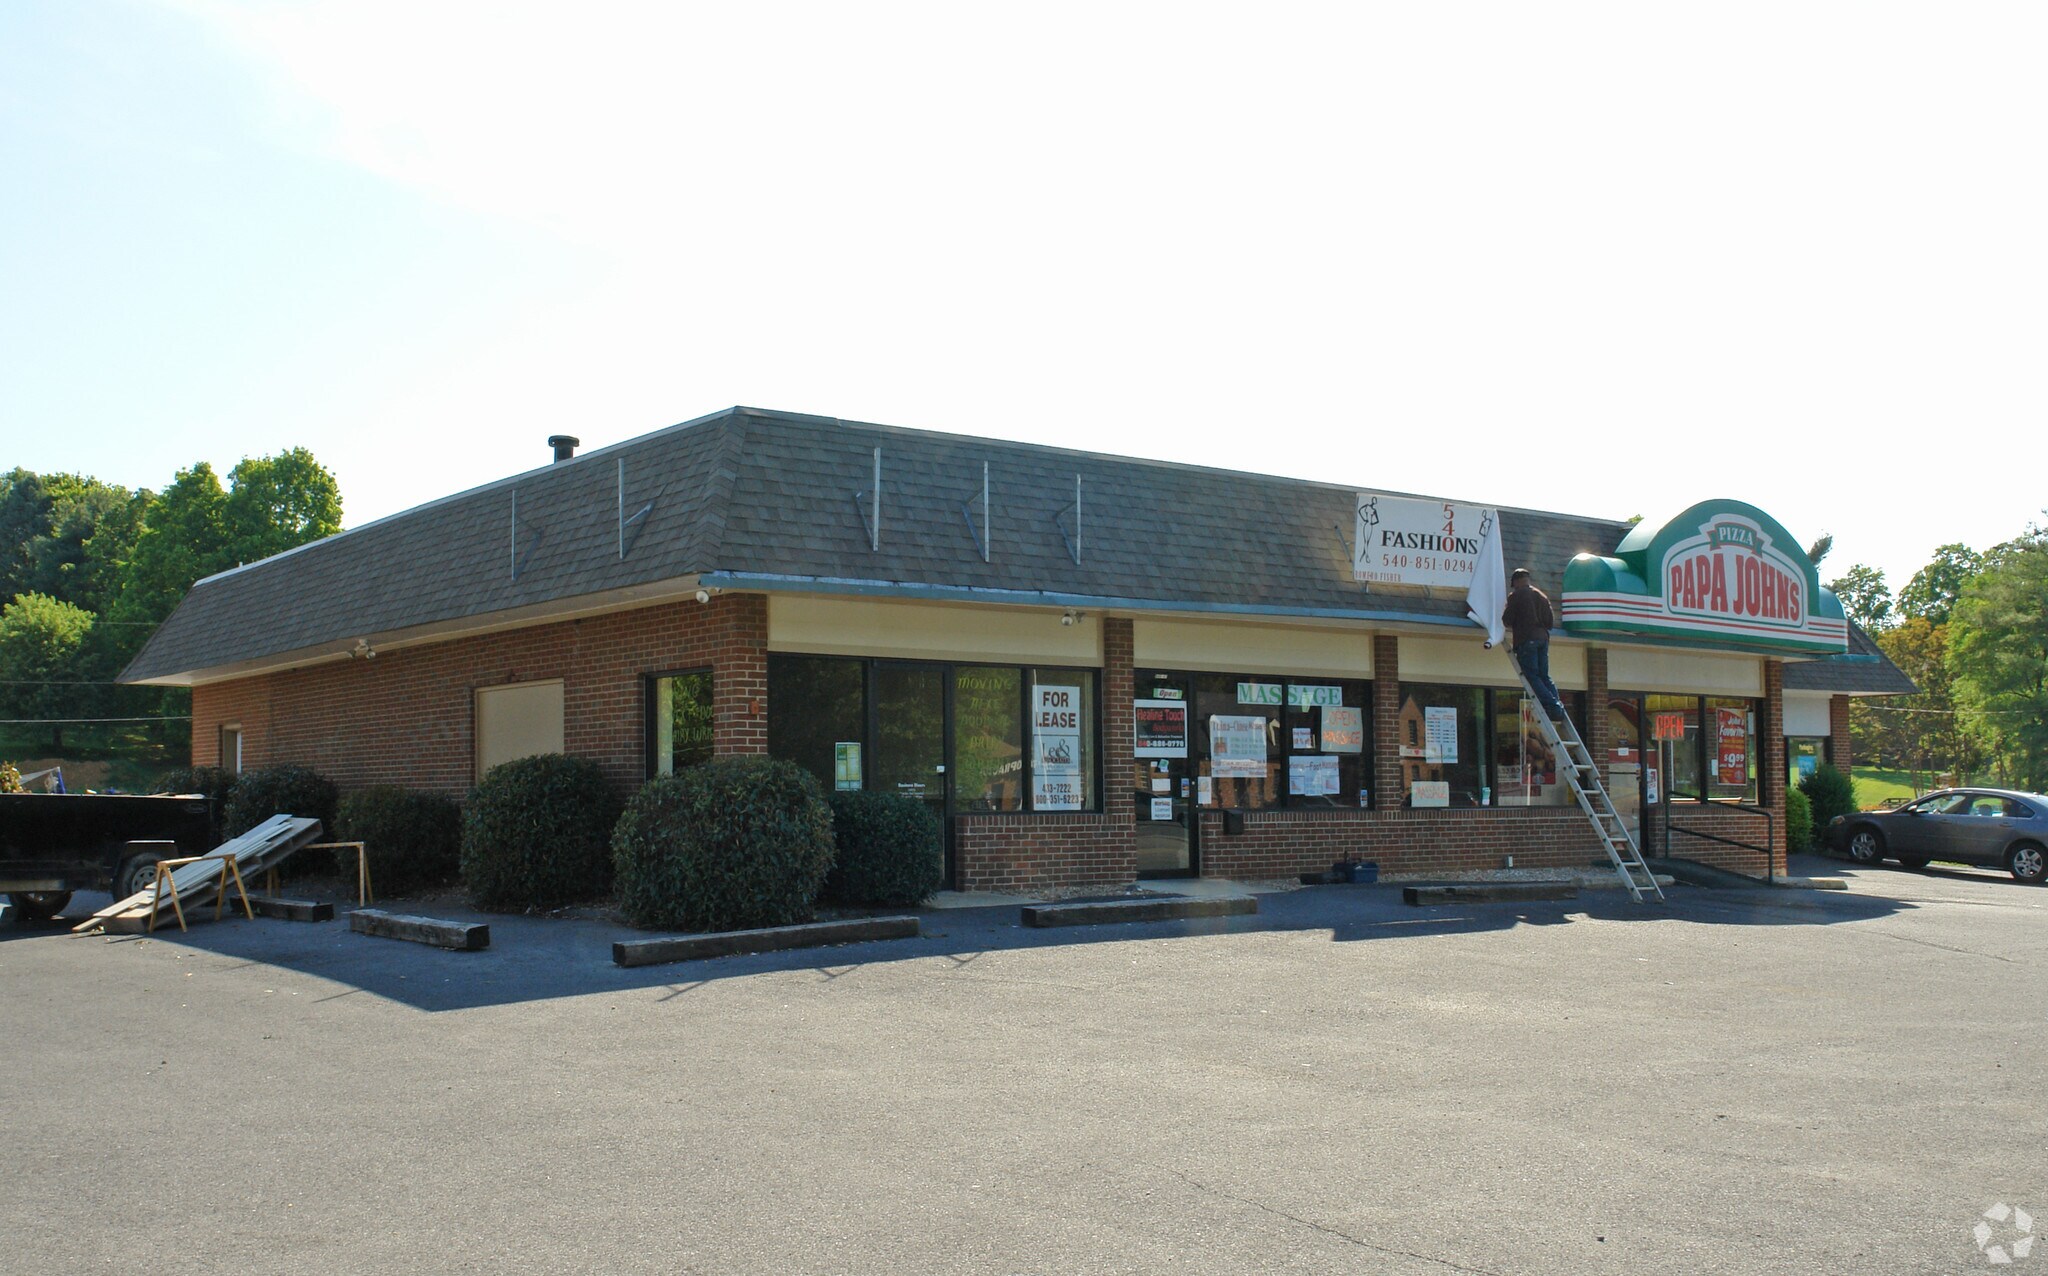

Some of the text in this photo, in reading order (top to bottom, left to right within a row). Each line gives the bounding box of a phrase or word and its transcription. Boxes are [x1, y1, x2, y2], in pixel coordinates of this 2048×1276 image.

[1381, 530, 1478, 555] FASHIONS
[1719, 526, 1753, 546] PIZZA
[1671, 553, 1728, 613] PAPA
[1043, 691, 1069, 707] FOR
[1036, 712, 1077, 728] LEASE
[1656, 714, 1684, 738] OPEN
